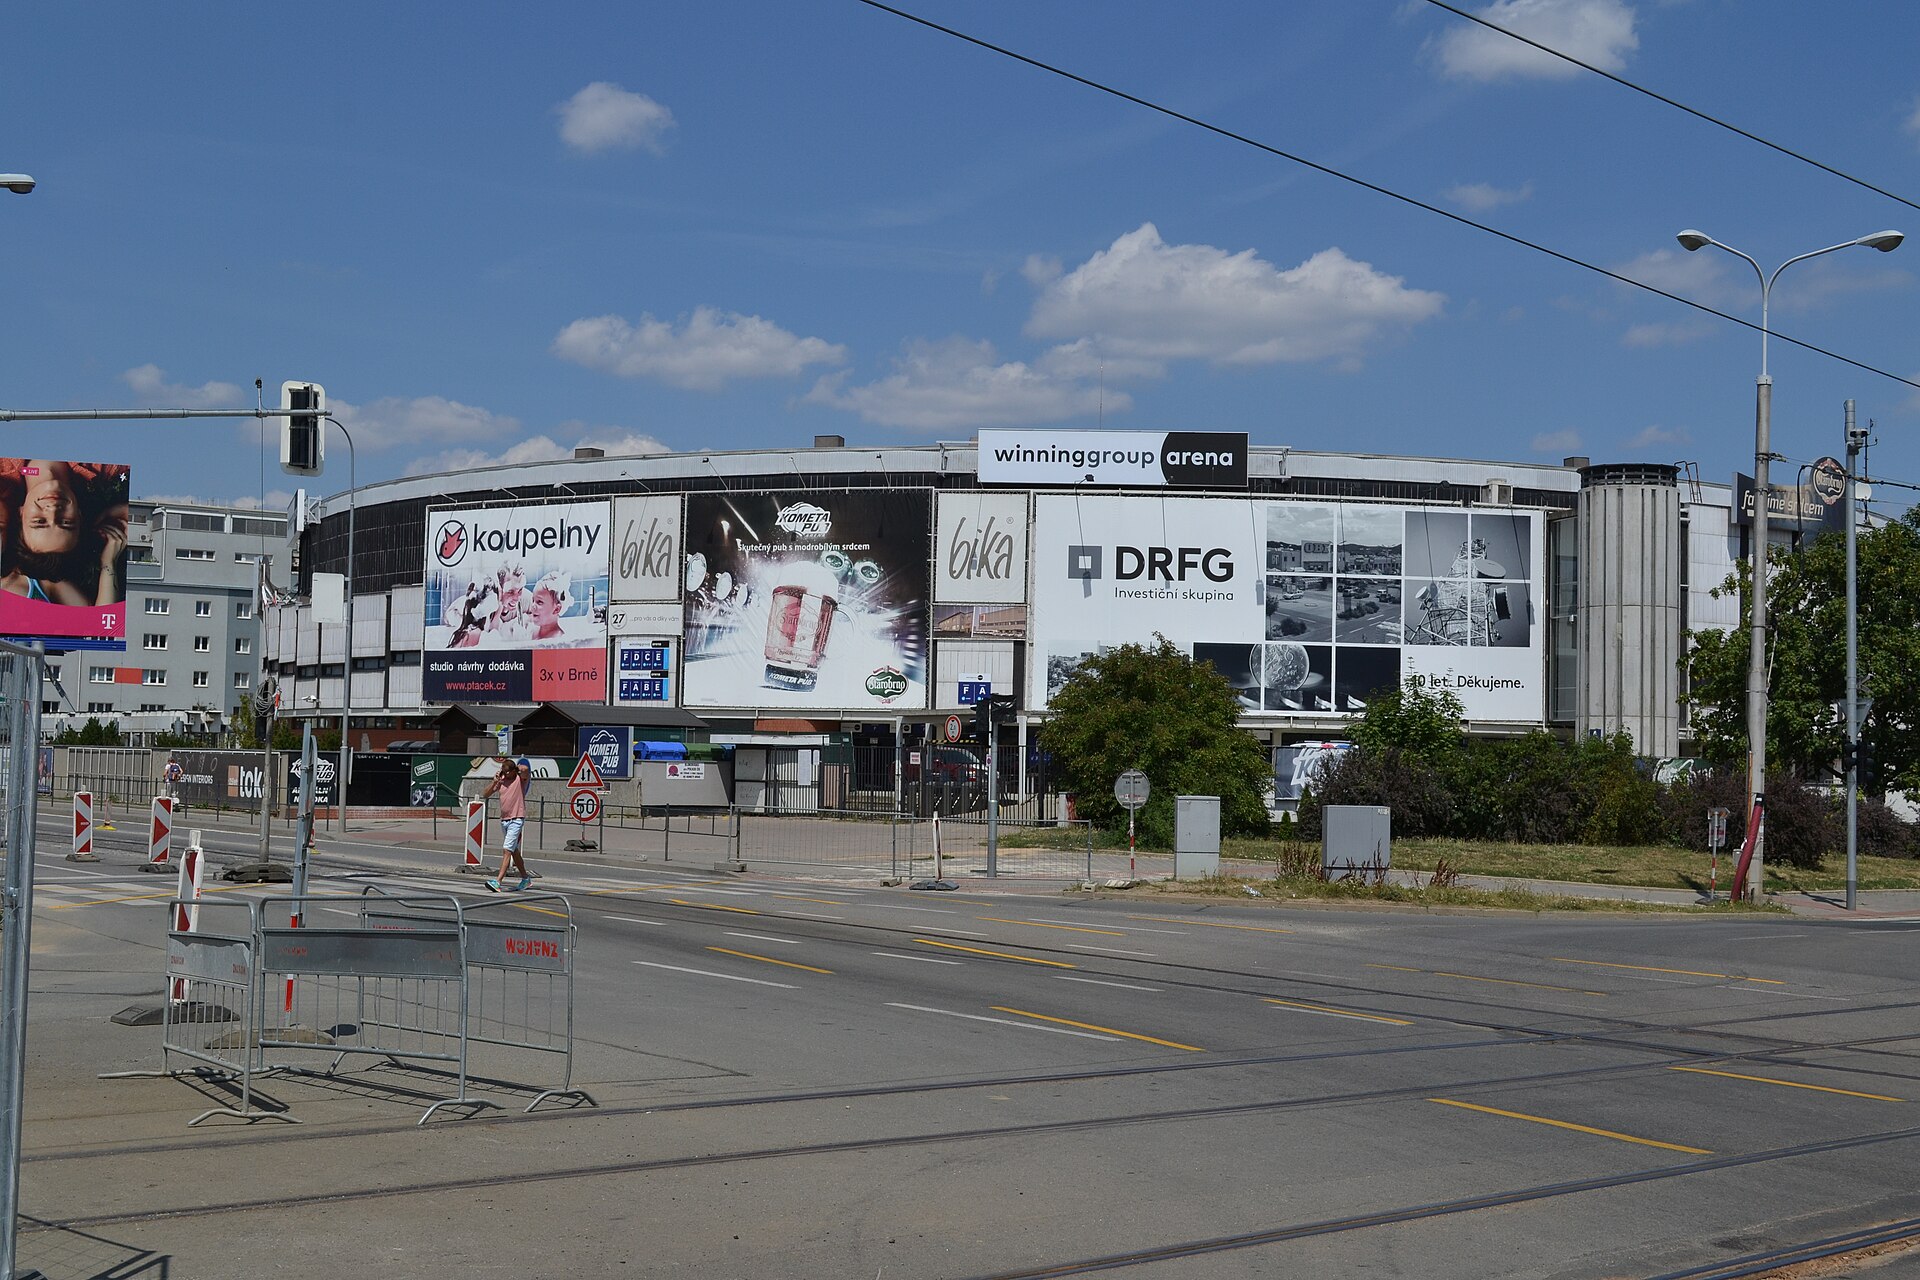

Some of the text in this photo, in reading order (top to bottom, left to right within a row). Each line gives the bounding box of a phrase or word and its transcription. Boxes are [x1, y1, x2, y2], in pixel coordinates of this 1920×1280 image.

[1166, 449, 1233, 466] arena
[778, 512, 829, 523] KOMETA
[473, 518, 601, 557] koupelny
[773, 543, 787, 553] pub
[842, 542, 870, 550] srdcem
[1115, 546, 1234, 583] DRFG
[1114, 587, 1234, 603] Investiční skupina
[613, 614, 625, 624] 27
[430, 661, 524, 673] studio návrhy dodávka
[539, 667, 598, 681] 3x v Brně
[446, 680, 506, 692] www.ptacek.cz
[633, 683, 639, 691] A
[644, 683, 650, 691] B
[1457, 674, 1525, 692] Děkujeme.
[963, 686, 986, 695] F A
[588, 743, 619, 755] KOMETA
[601, 756, 619, 767] PUB
[576, 798, 594, 815] 50
